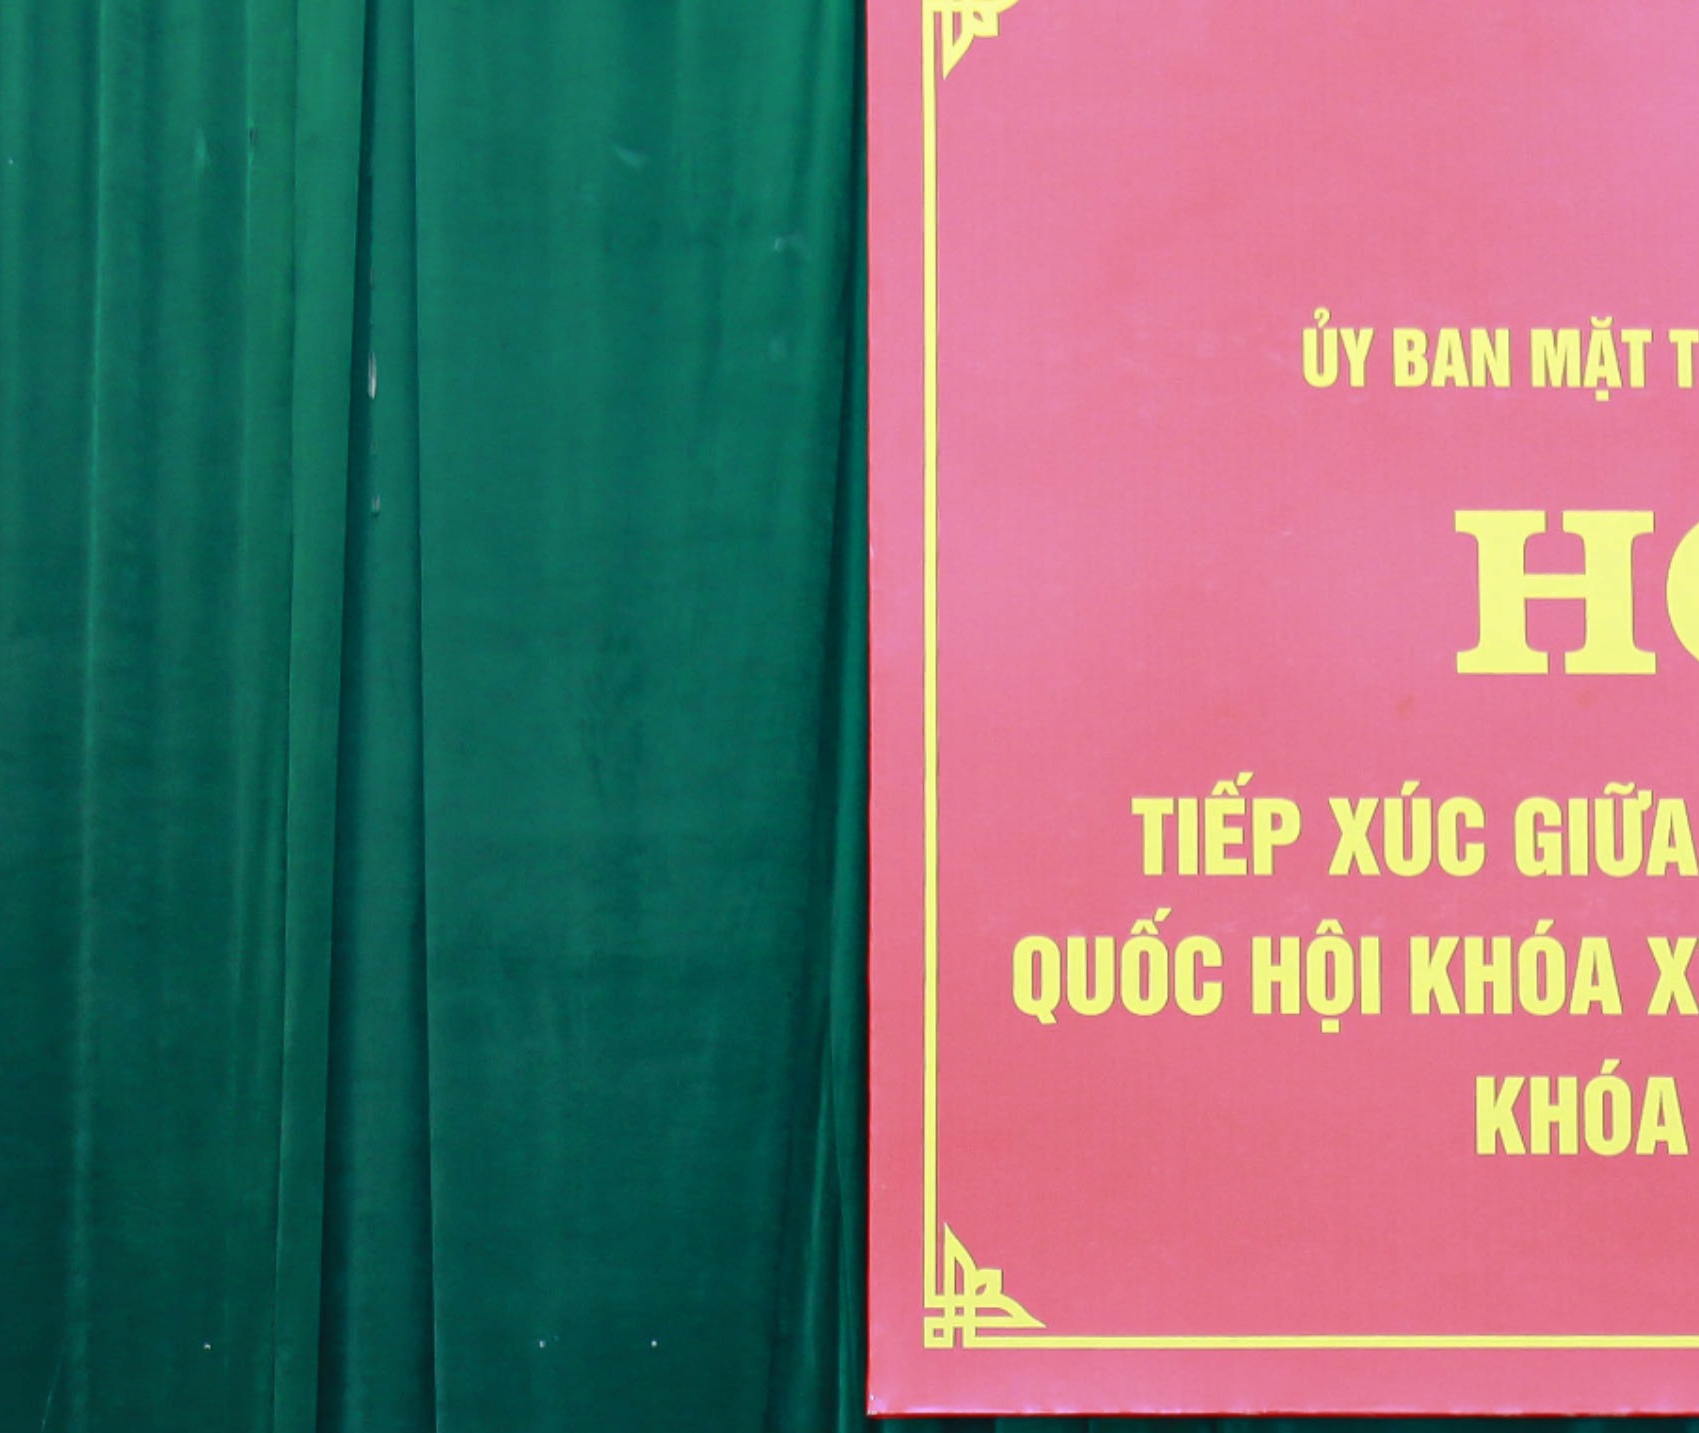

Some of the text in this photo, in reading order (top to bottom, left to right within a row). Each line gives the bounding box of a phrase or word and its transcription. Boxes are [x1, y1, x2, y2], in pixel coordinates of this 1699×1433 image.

[1303, 308, 1374, 387] ỦY
[1394, 329, 1510, 387] BAN
[1530, 318, 1652, 400] MẶT
[1132, 772, 1301, 875] TIẾP
[1329, 781, 1485, 876] XÚC
[1515, 783, 1698, 876] GIỮA
[1013, 908, 1222, 1024] QUỐC
[1252, 920, 1380, 1033] HỘI
[1411, 920, 1622, 1015] KHÓA
[1476, 1060, 1688, 1155] KHÓA
